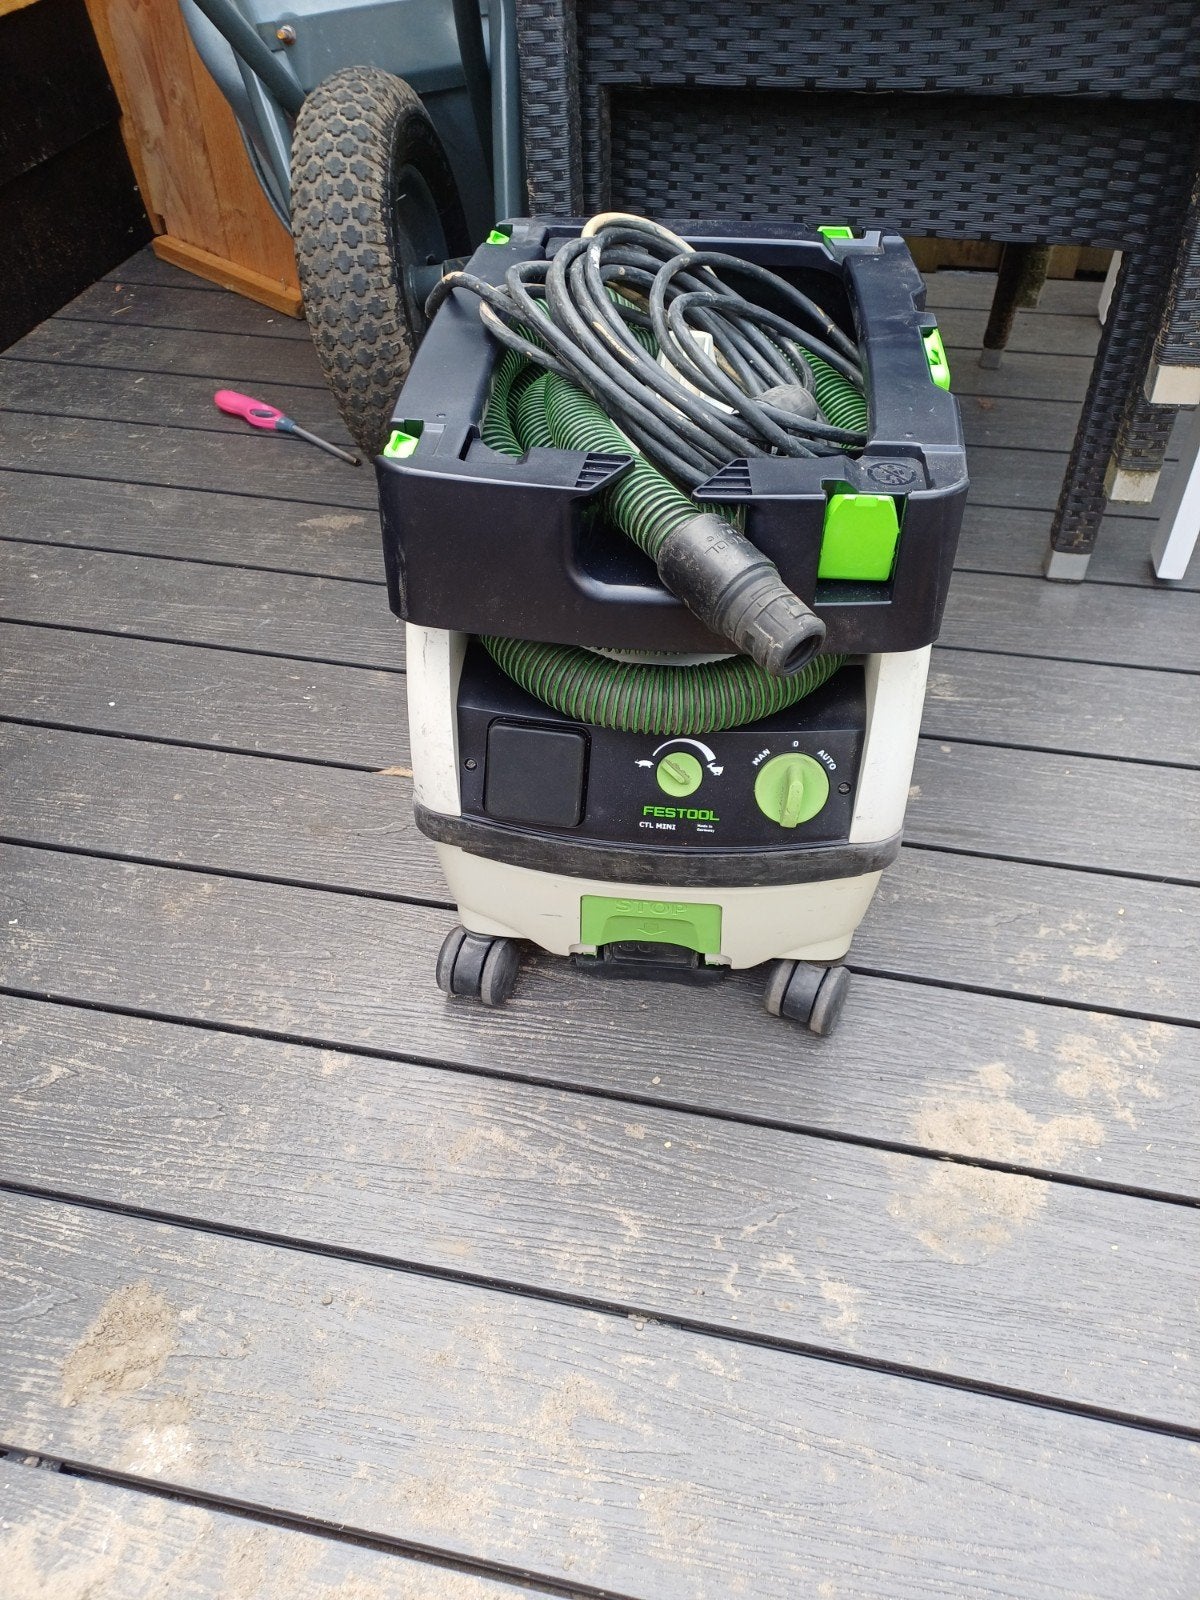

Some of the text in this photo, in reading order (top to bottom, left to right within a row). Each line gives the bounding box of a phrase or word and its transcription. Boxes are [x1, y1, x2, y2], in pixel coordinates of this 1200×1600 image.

[752, 748, 771, 766] MAN
[817, 749, 837, 771] AUTO
[643, 805, 720, 821] FESTOOL
[639, 821, 676, 831] CTL MINI
[615, 900, 688, 916] STOP
